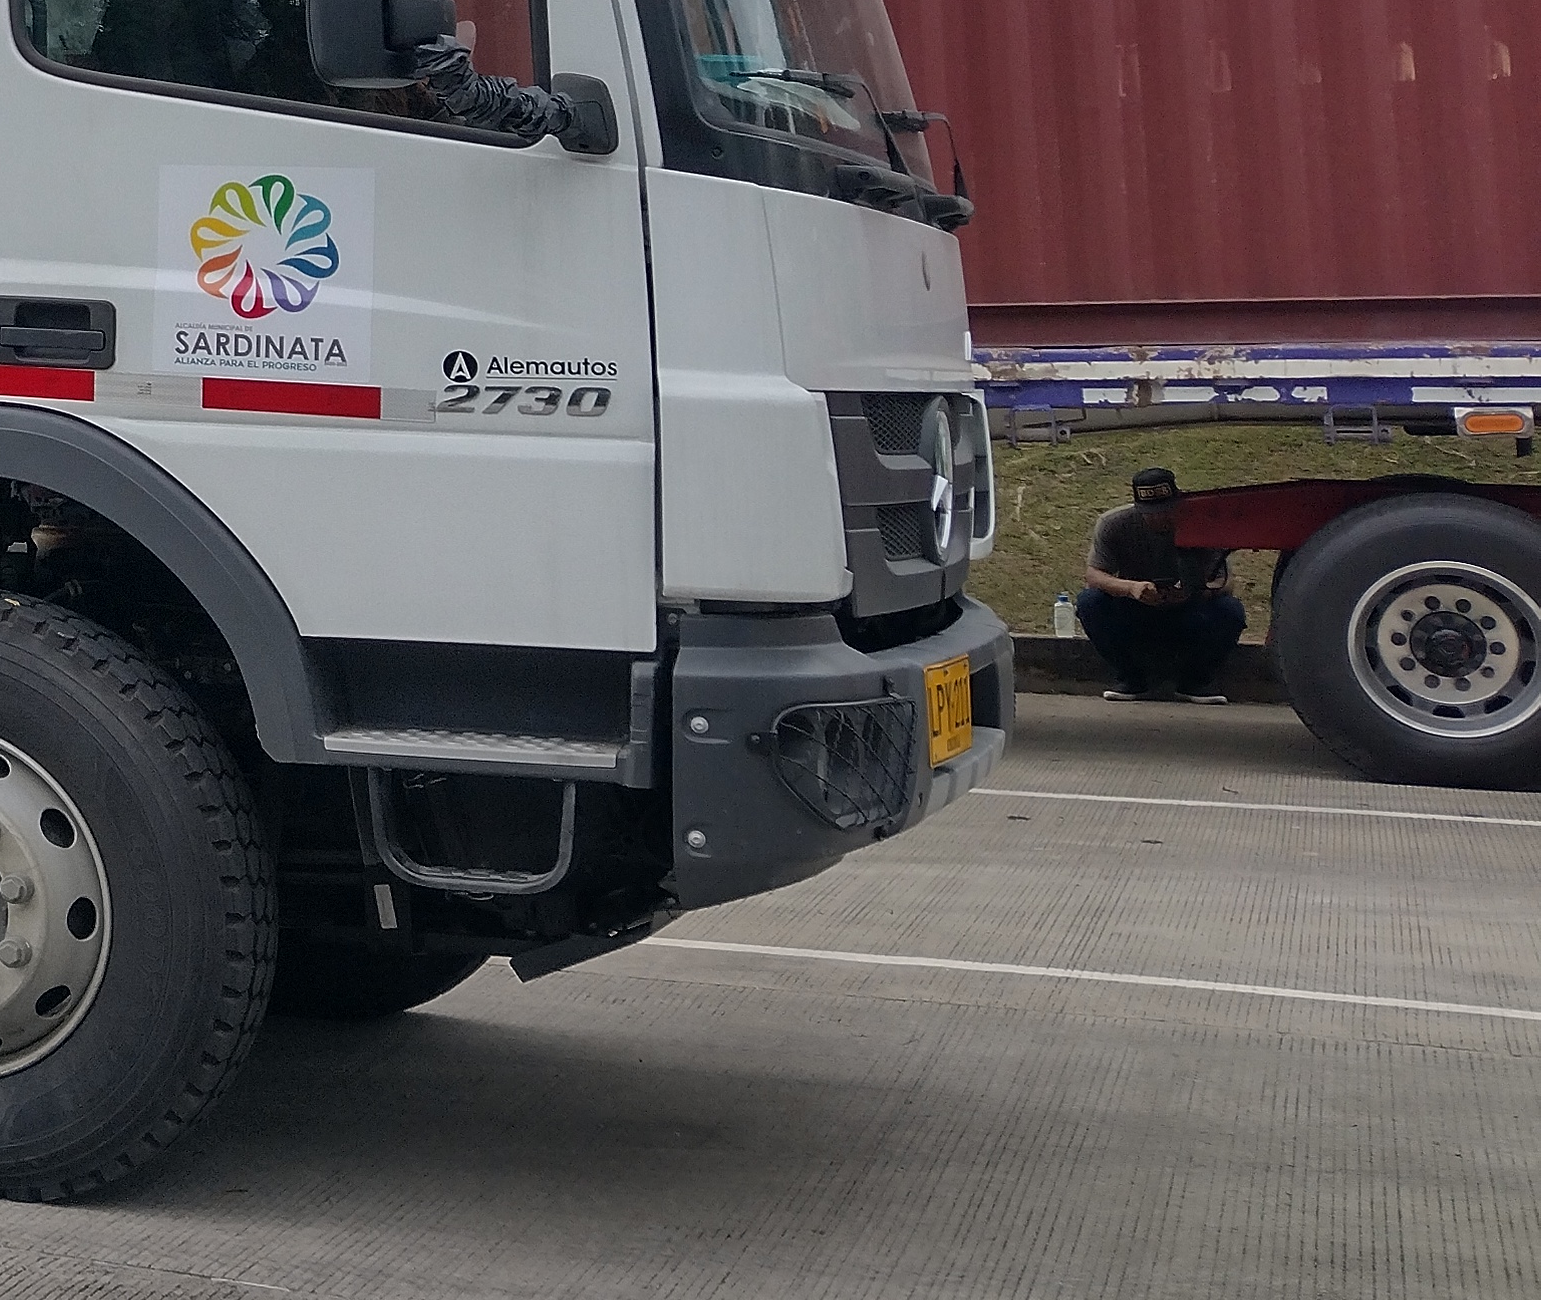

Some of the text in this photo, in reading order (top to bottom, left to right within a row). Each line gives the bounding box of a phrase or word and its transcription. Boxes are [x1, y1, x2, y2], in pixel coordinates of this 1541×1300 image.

[174, 330, 347, 362] SARDINATA
[174, 357, 216, 366] ALIANZA
[219, 359, 244, 368] PARA
[247, 360, 259, 368] EL
[262, 361, 317, 371] PROGRESO
[486, 356, 617, 376] Alemautos
[437, 384, 612, 417] 2730
